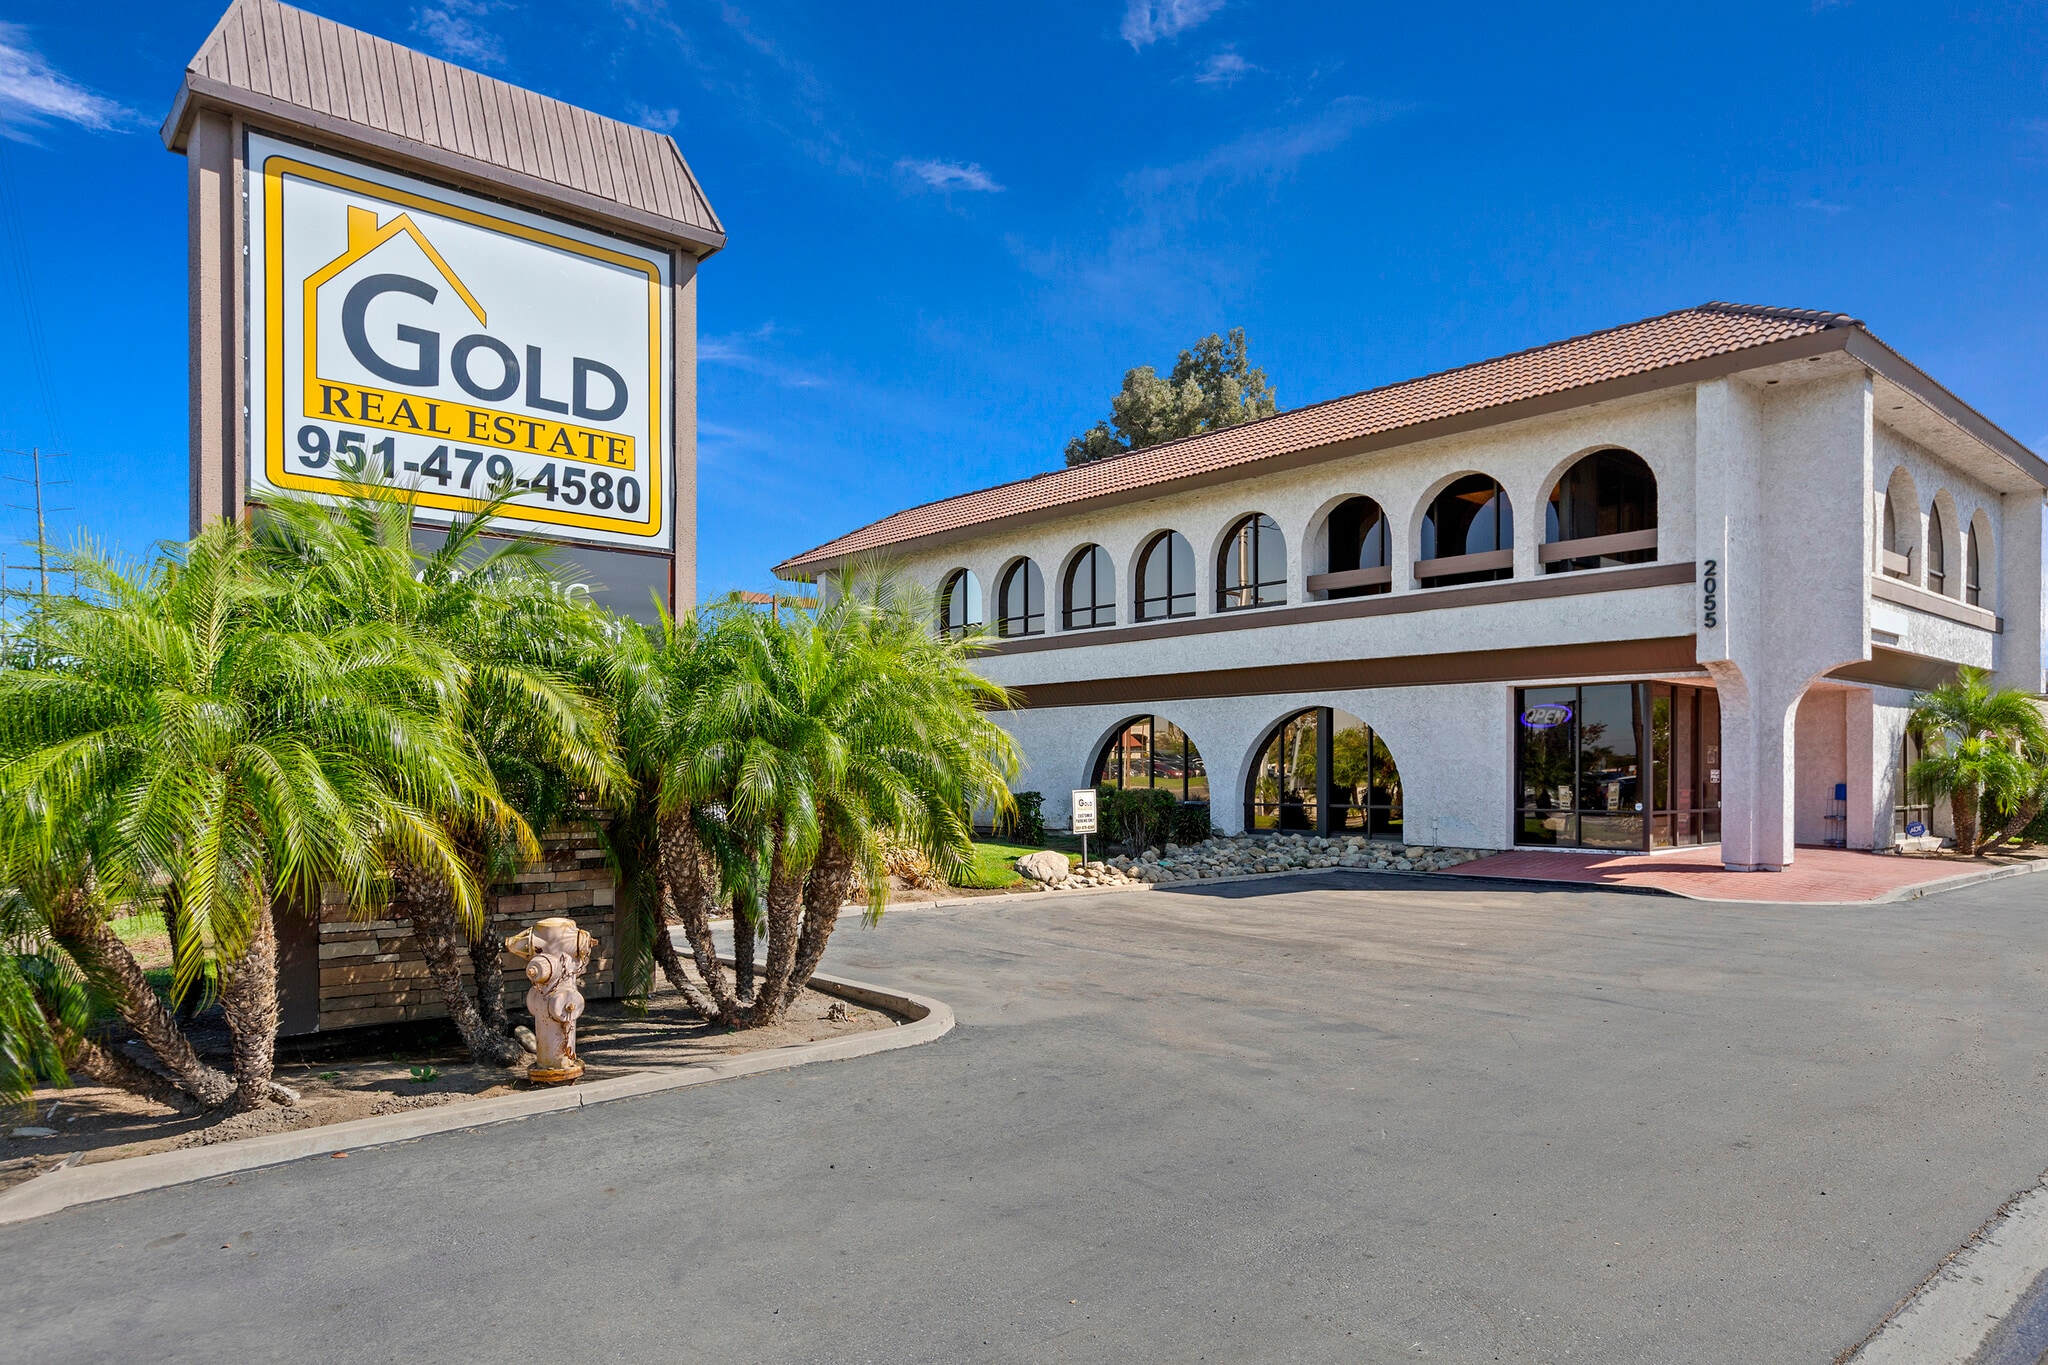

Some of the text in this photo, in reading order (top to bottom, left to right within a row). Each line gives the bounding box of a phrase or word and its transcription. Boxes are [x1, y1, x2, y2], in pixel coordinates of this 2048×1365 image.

[341, 273, 629, 421] GOLD
[318, 384, 628, 466] REAL ESTATE
[297, 424, 641, 514] 951-479-4580
[1703, 559, 1718, 629] 2055
[1525, 708, 1566, 724] OPEN
